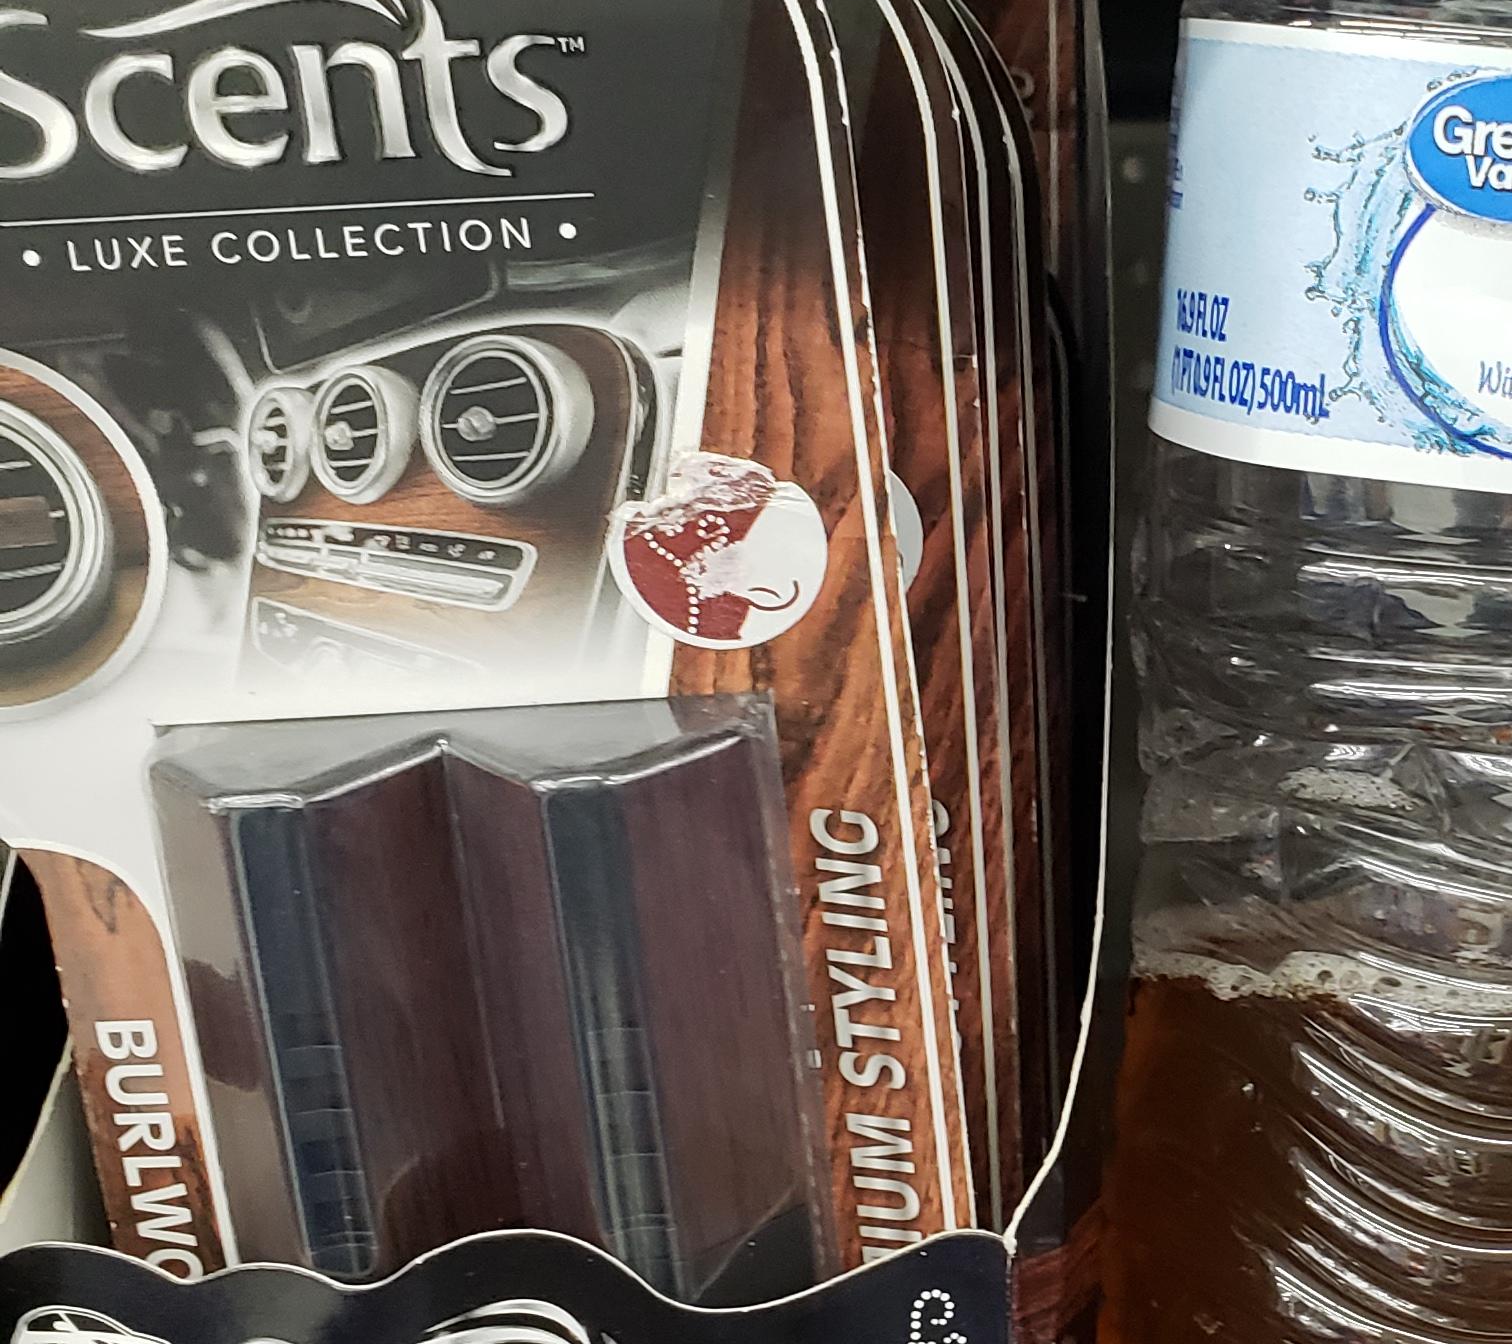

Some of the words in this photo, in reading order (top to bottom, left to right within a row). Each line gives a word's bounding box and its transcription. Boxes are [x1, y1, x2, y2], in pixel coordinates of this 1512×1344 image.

[66, 235, 188, 273] LUXE
[210, 217, 533, 262] COLLECTION
[1210, 294, 1230, 343] OZ
[1256, 366, 1331, 419] 500mL
[809, 808, 907, 1091] STYLING
